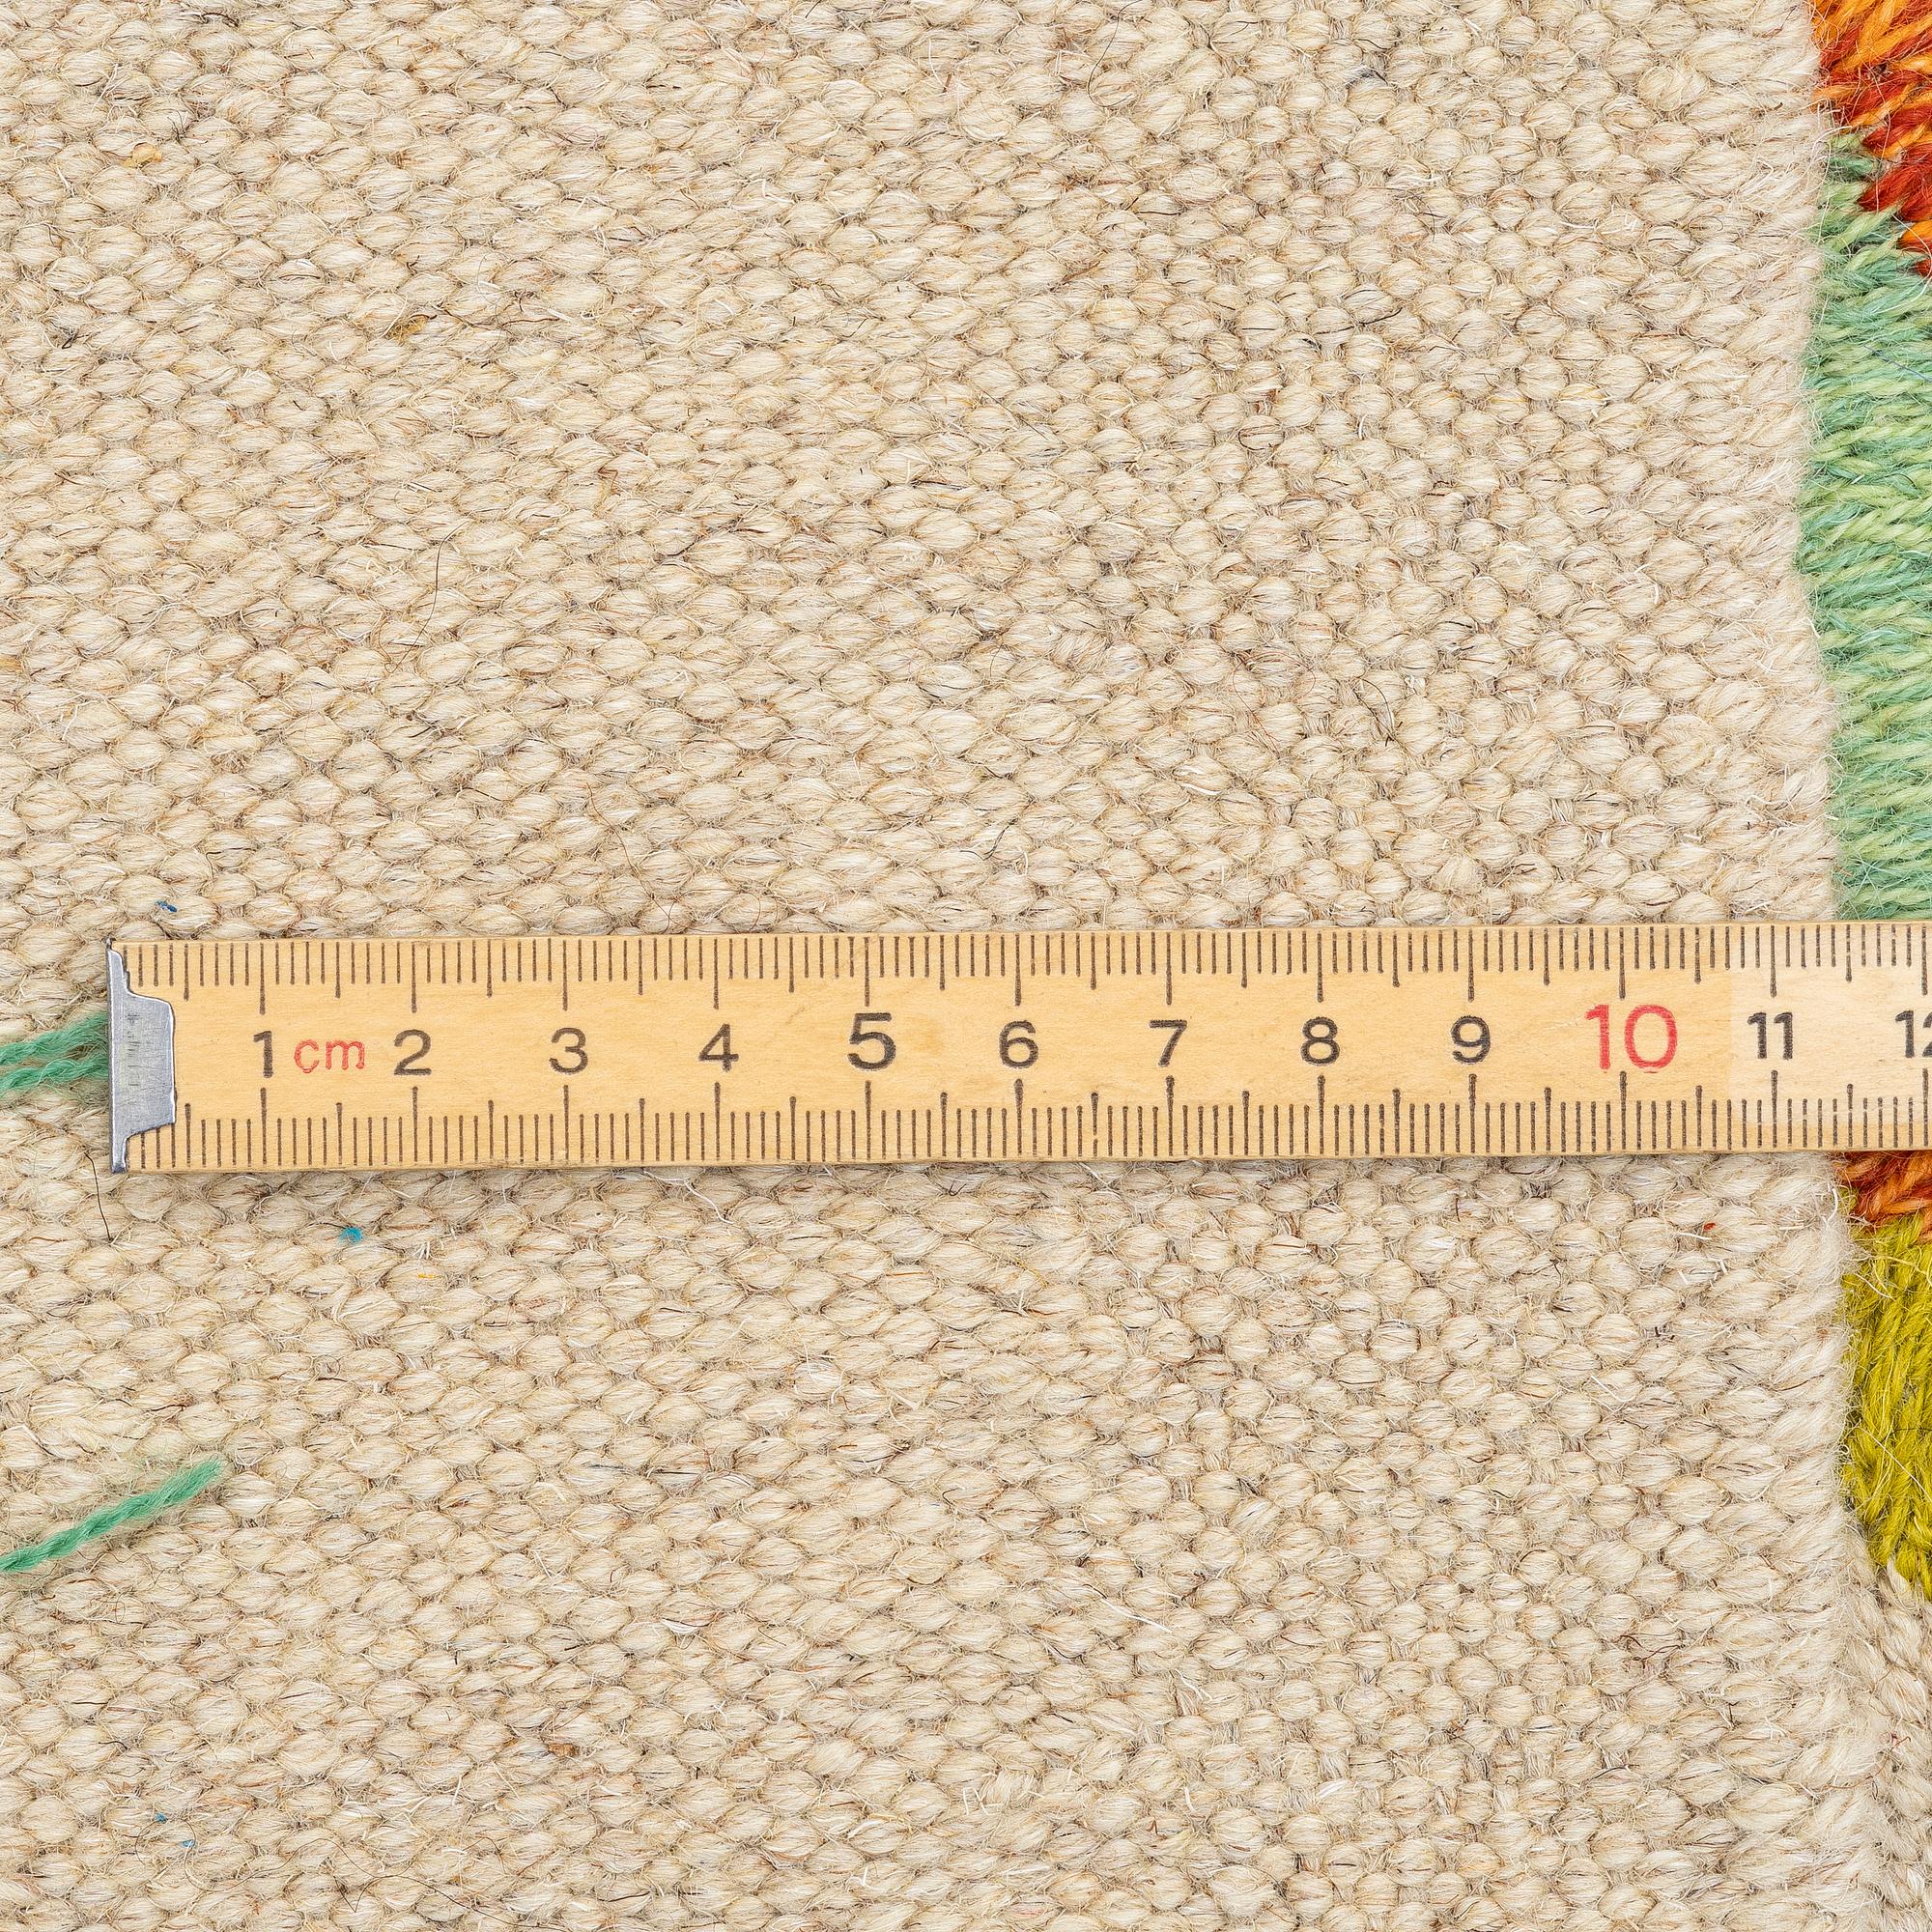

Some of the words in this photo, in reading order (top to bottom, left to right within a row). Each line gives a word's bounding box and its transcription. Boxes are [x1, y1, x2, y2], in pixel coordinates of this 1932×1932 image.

[253, 1030, 274, 1078] 1
[293, 1038, 366, 1072] cm
[394, 1028, 432, 1076] 2
[549, 1027, 588, 1076] 3
[698, 1024, 740, 1072] 4
[847, 1011, 896, 1071] 5
[998, 1019, 1039, 1069] 6
[1149, 1018, 1188, 1067] 7
[1300, 1015, 1341, 1066] 8
[1451, 1014, 1492, 1065] 9
[1585, 1004, 1679, 1070] 10
[1747, 1011, 1794, 1061] 11
